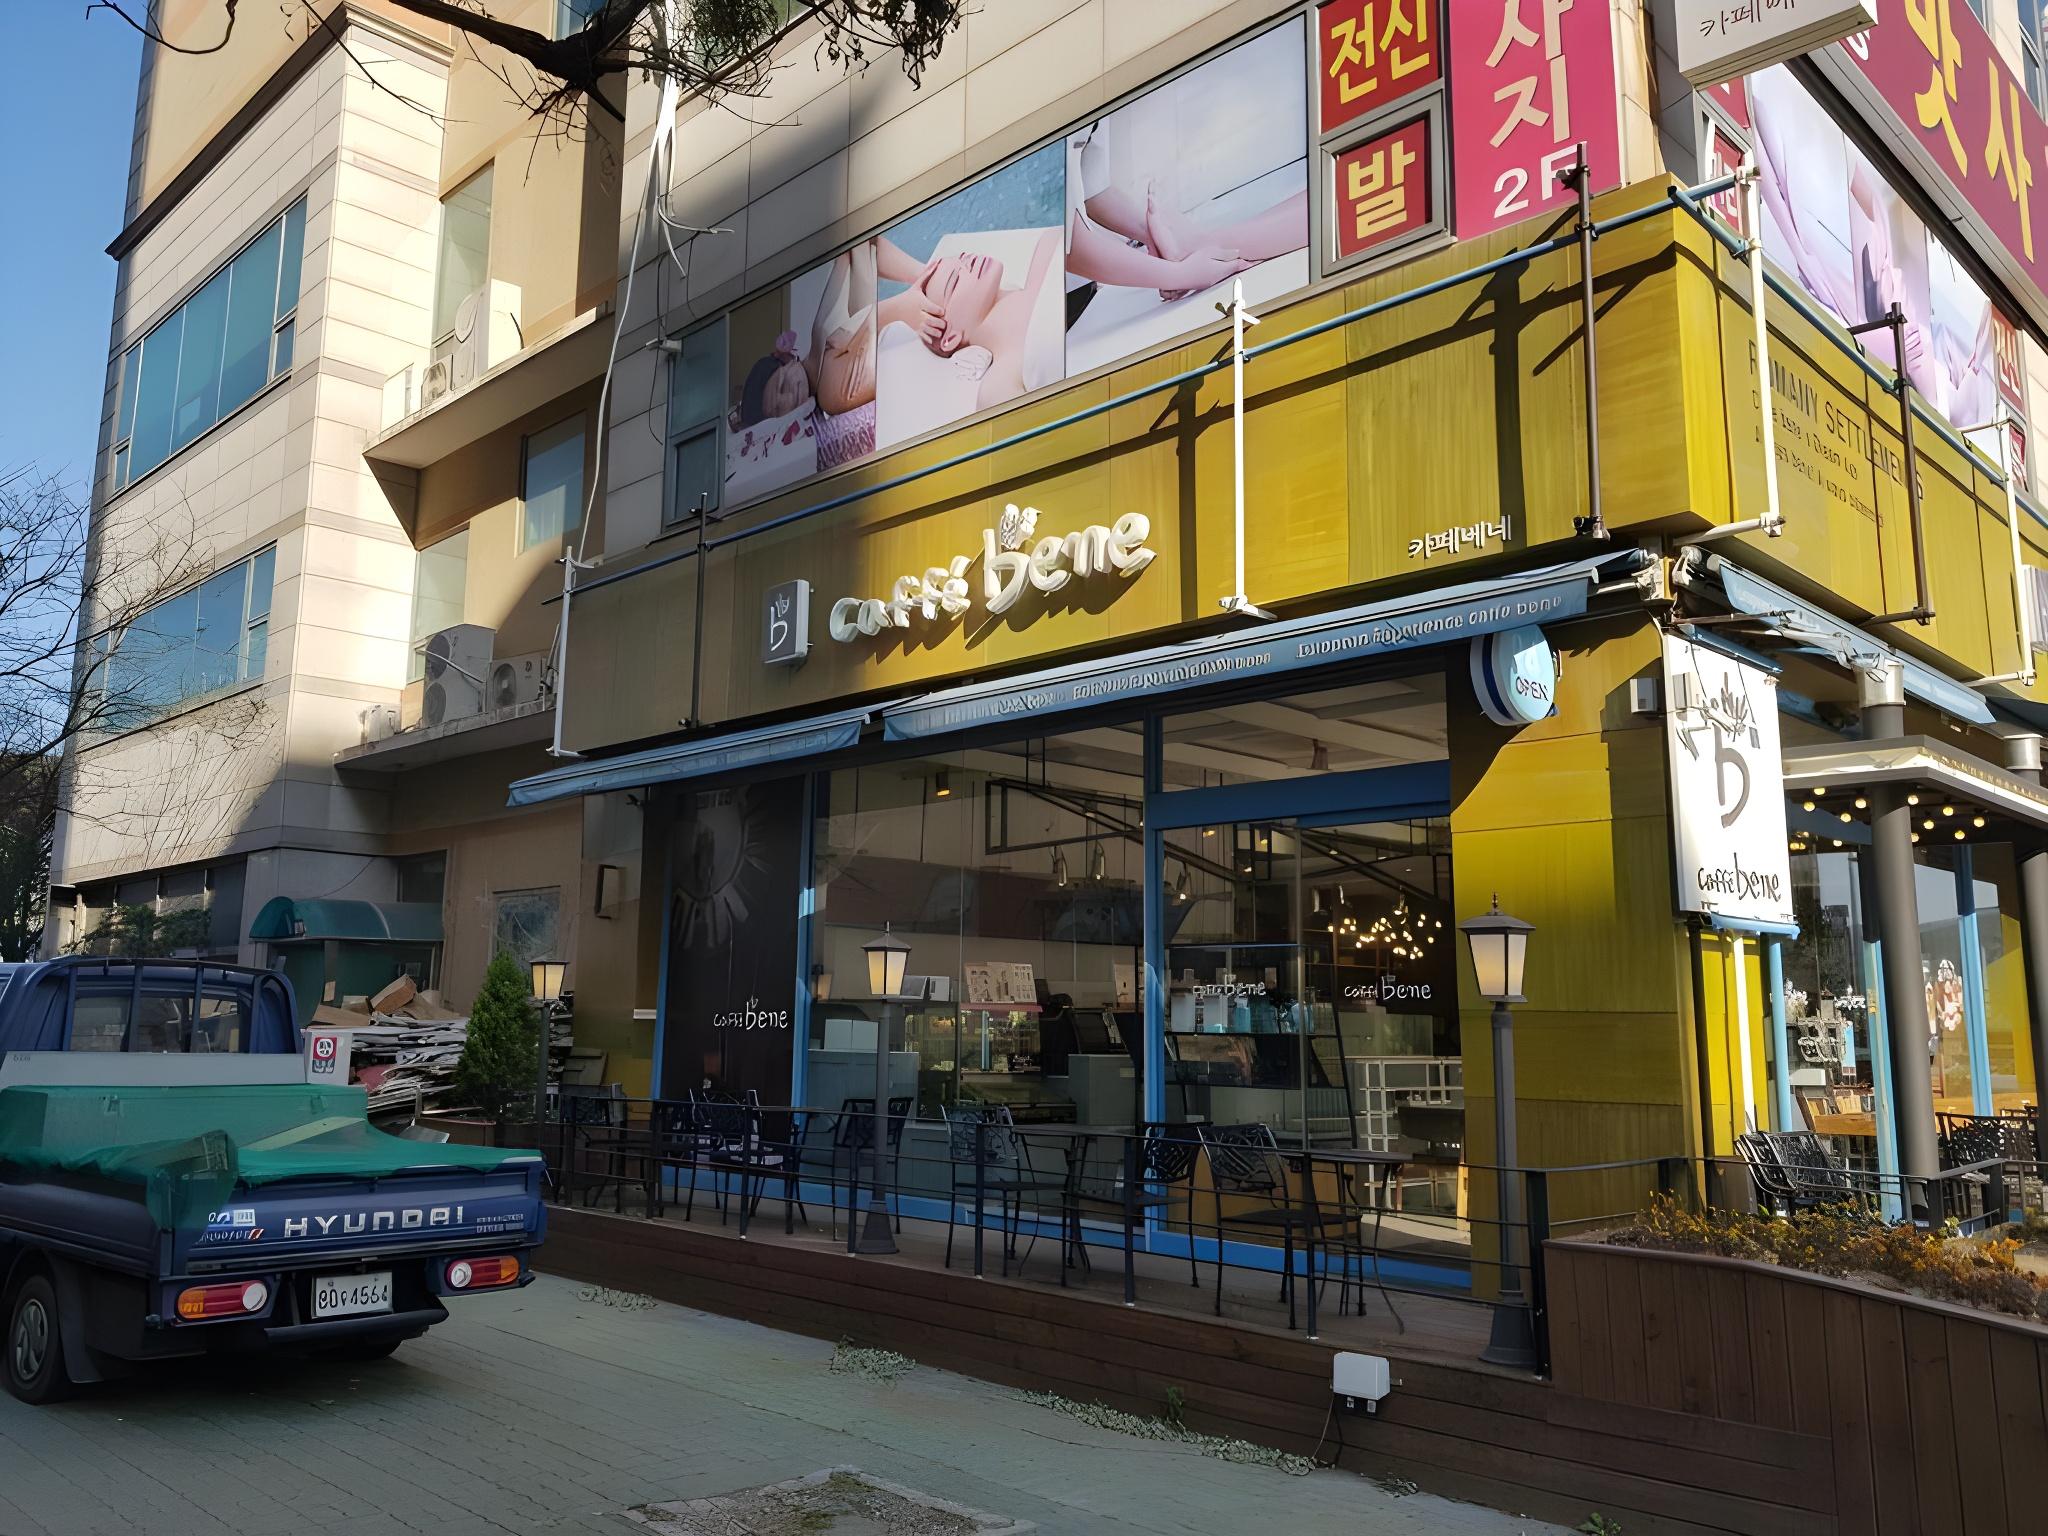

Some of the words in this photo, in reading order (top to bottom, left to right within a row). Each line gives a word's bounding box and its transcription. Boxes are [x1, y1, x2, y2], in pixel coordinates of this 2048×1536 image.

[1329, 0, 1431, 105] 전신
[1348, 140, 1416, 240] 발
[1493, 140, 1588, 219] 2F
[1408, 513, 1511, 558] 카페베네
[983, 511, 1157, 615] bene
[1515, 675, 1549, 702] OPEN
[1380, 975, 1433, 1000] bene
[745, 1000, 789, 1031] bene
[284, 1205, 464, 1238] HYUNDAI
